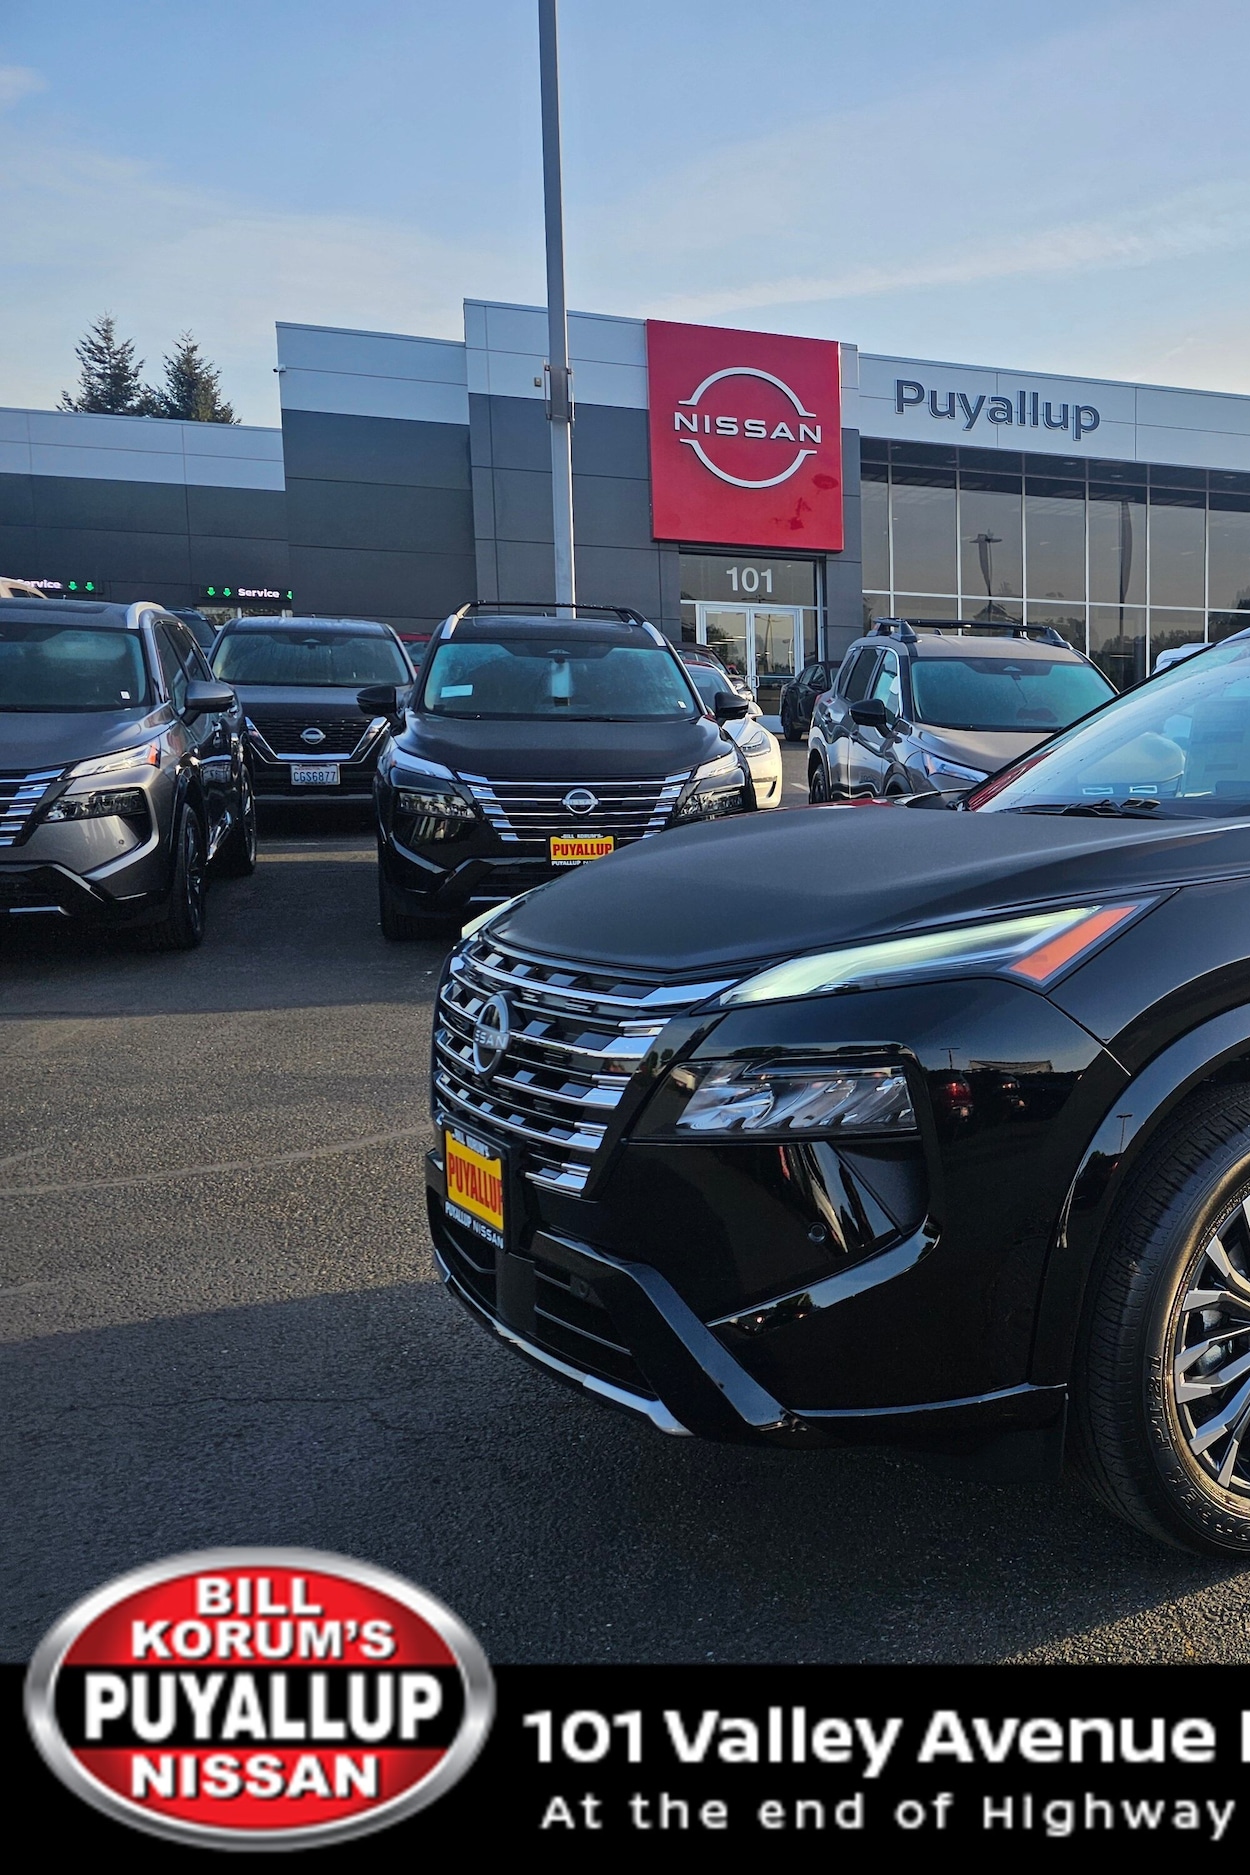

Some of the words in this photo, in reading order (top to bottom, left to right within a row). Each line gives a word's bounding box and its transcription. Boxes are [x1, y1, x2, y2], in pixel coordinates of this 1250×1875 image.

[895, 378, 1100, 441] Puyallup
[674, 411, 822, 444] NISSAN
[237, 587, 280, 598] Service
[726, 566, 773, 593] 101
[293, 771, 336, 782] CGS6877
[552, 843, 612, 856] PUYALLUP
[448, 1152, 503, 1216] PUYALLUP
[472, 1220, 504, 1250] NISSAN
